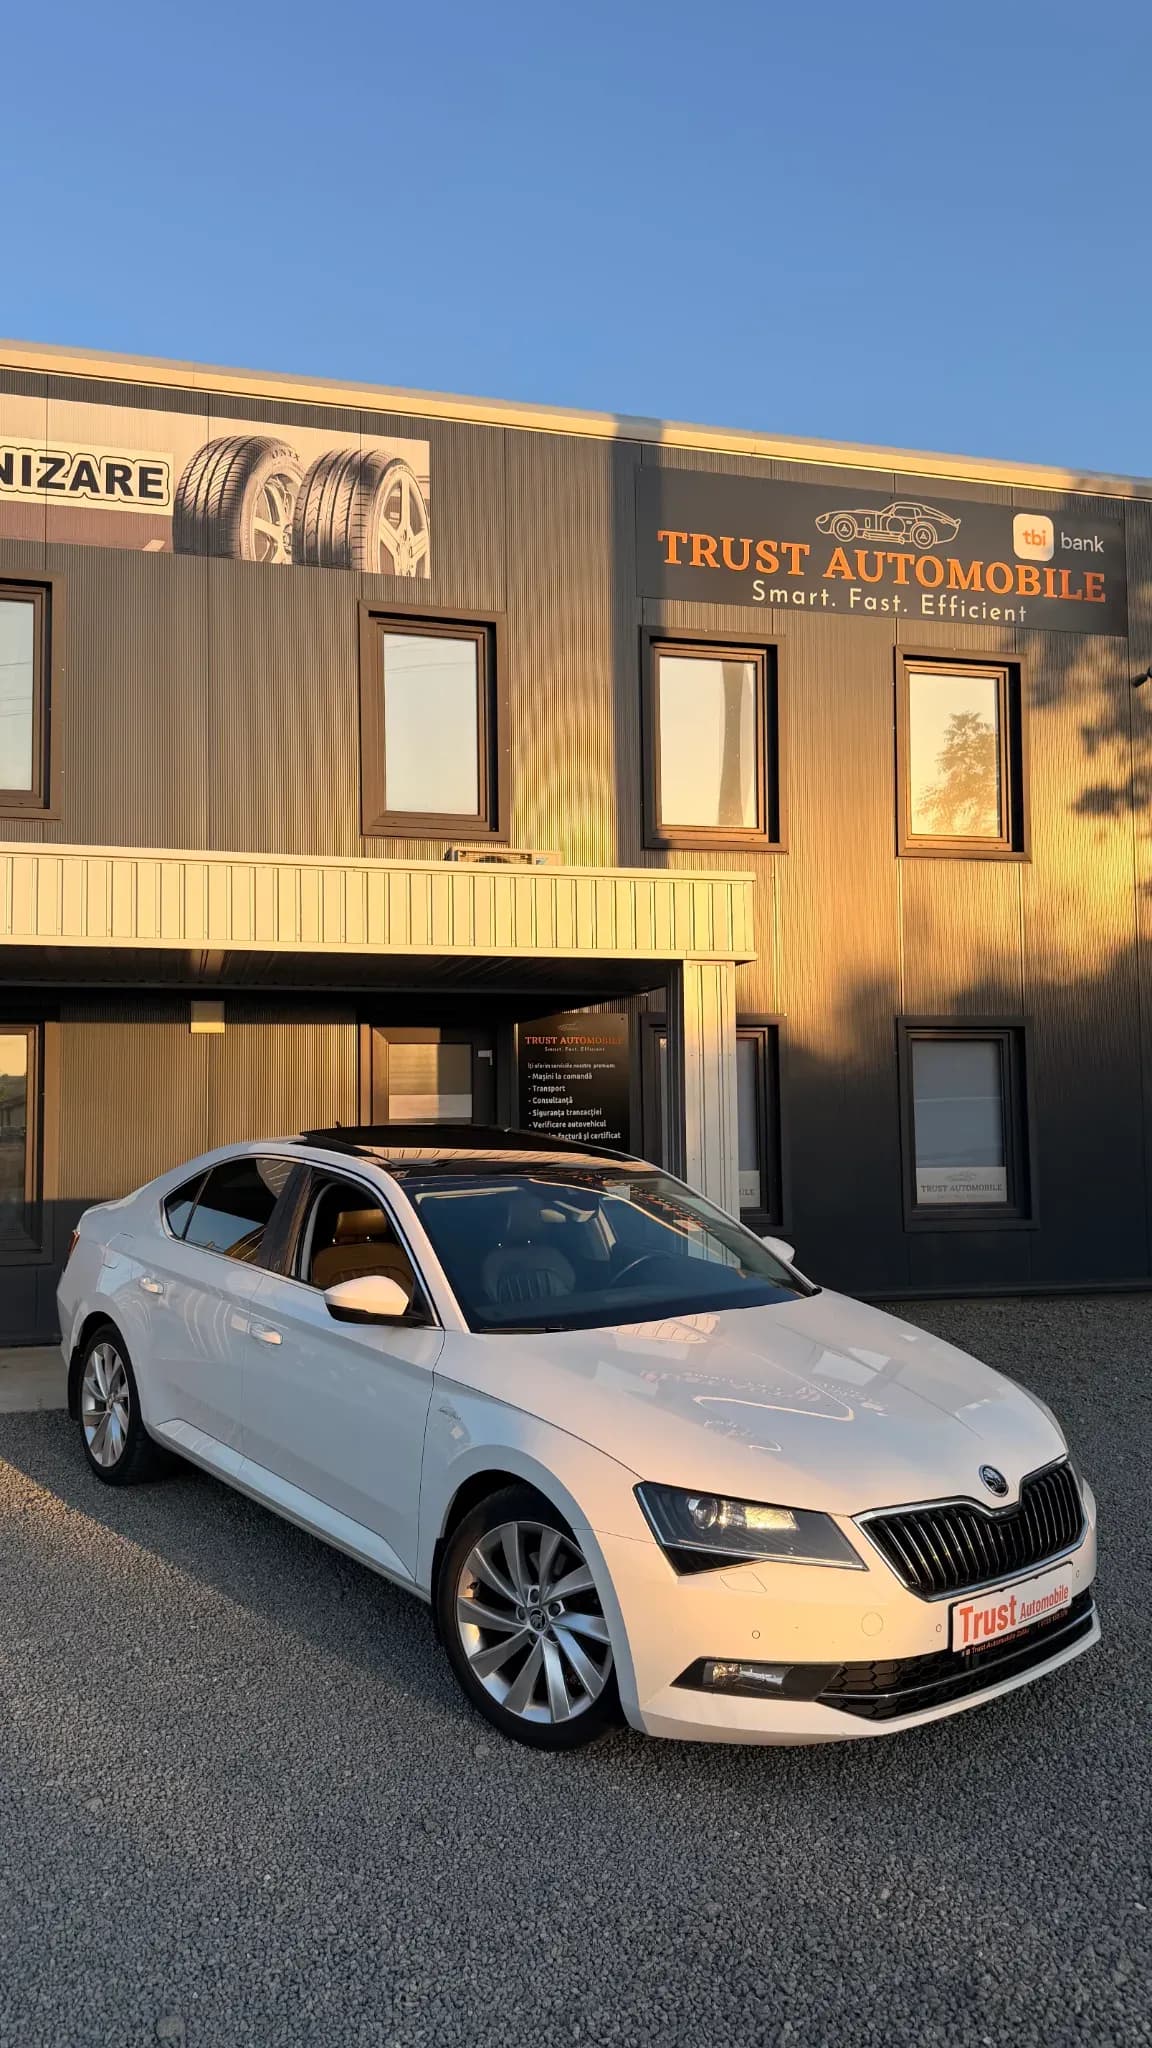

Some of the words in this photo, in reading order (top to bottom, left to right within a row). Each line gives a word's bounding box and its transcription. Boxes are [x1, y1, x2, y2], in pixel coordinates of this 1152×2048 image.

[1022, 530, 1047, 547] tbi
[1060, 532, 1104, 553] bank
[657, 530, 810, 576] TRUST
[822, 546, 1106, 603] AUTOMOBILE
[752, 579, 836, 607] Smart.
[850, 587, 908, 613] Fast.
[921, 593, 1027, 622] Efficient
[525, 1036, 558, 1045] TRUST
[555, 1072, 562, 1080] la
[532, 1085, 566, 1093] Transport
[532, 1120, 567, 1129] Verificare
[567, 1119, 607, 1128] autovehicul
[590, 1131, 621, 1139] certificat
[920, 1184, 948, 1193] TRUST
[950, 1183, 1004, 1192] AUTOMOBILE
[960, 1595, 1017, 1643] Trust
[1019, 1584, 1069, 1620] Automobile
